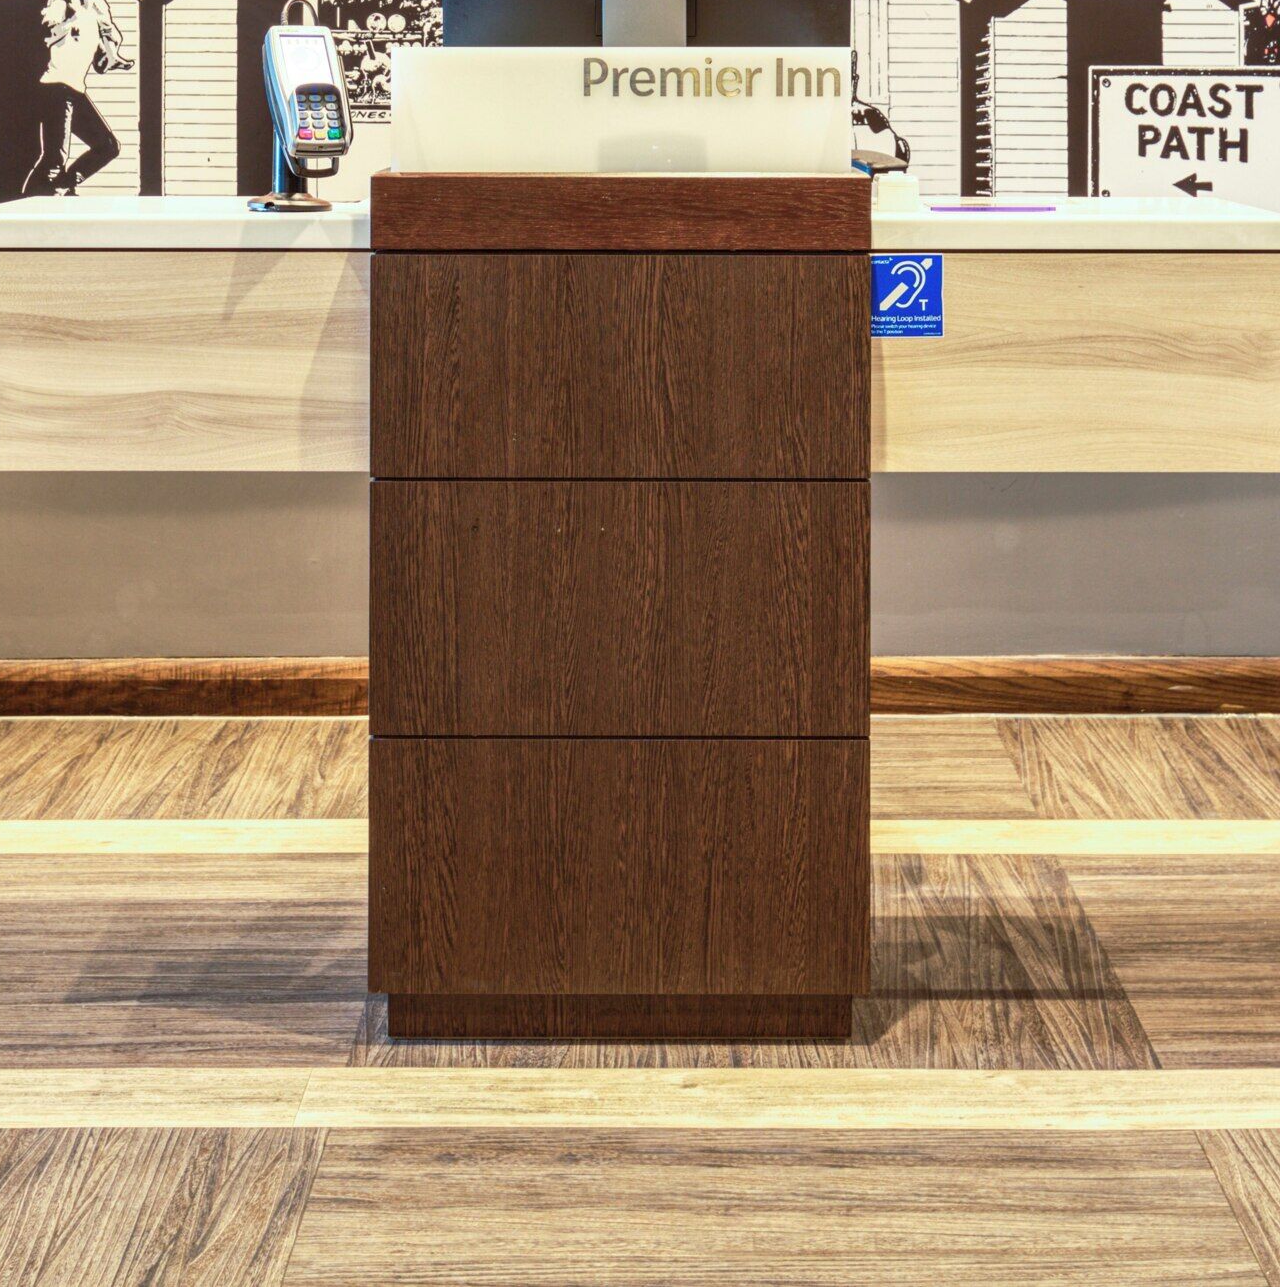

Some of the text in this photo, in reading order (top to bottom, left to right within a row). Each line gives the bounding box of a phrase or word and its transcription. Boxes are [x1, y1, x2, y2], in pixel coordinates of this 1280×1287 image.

[583, 57, 841, 97] Premier Inn
[1124, 83, 1264, 119] COAST
[1138, 124, 1248, 163] PATH
[871, 315, 896, 323] Hearing
[919, 299, 928, 311] T
